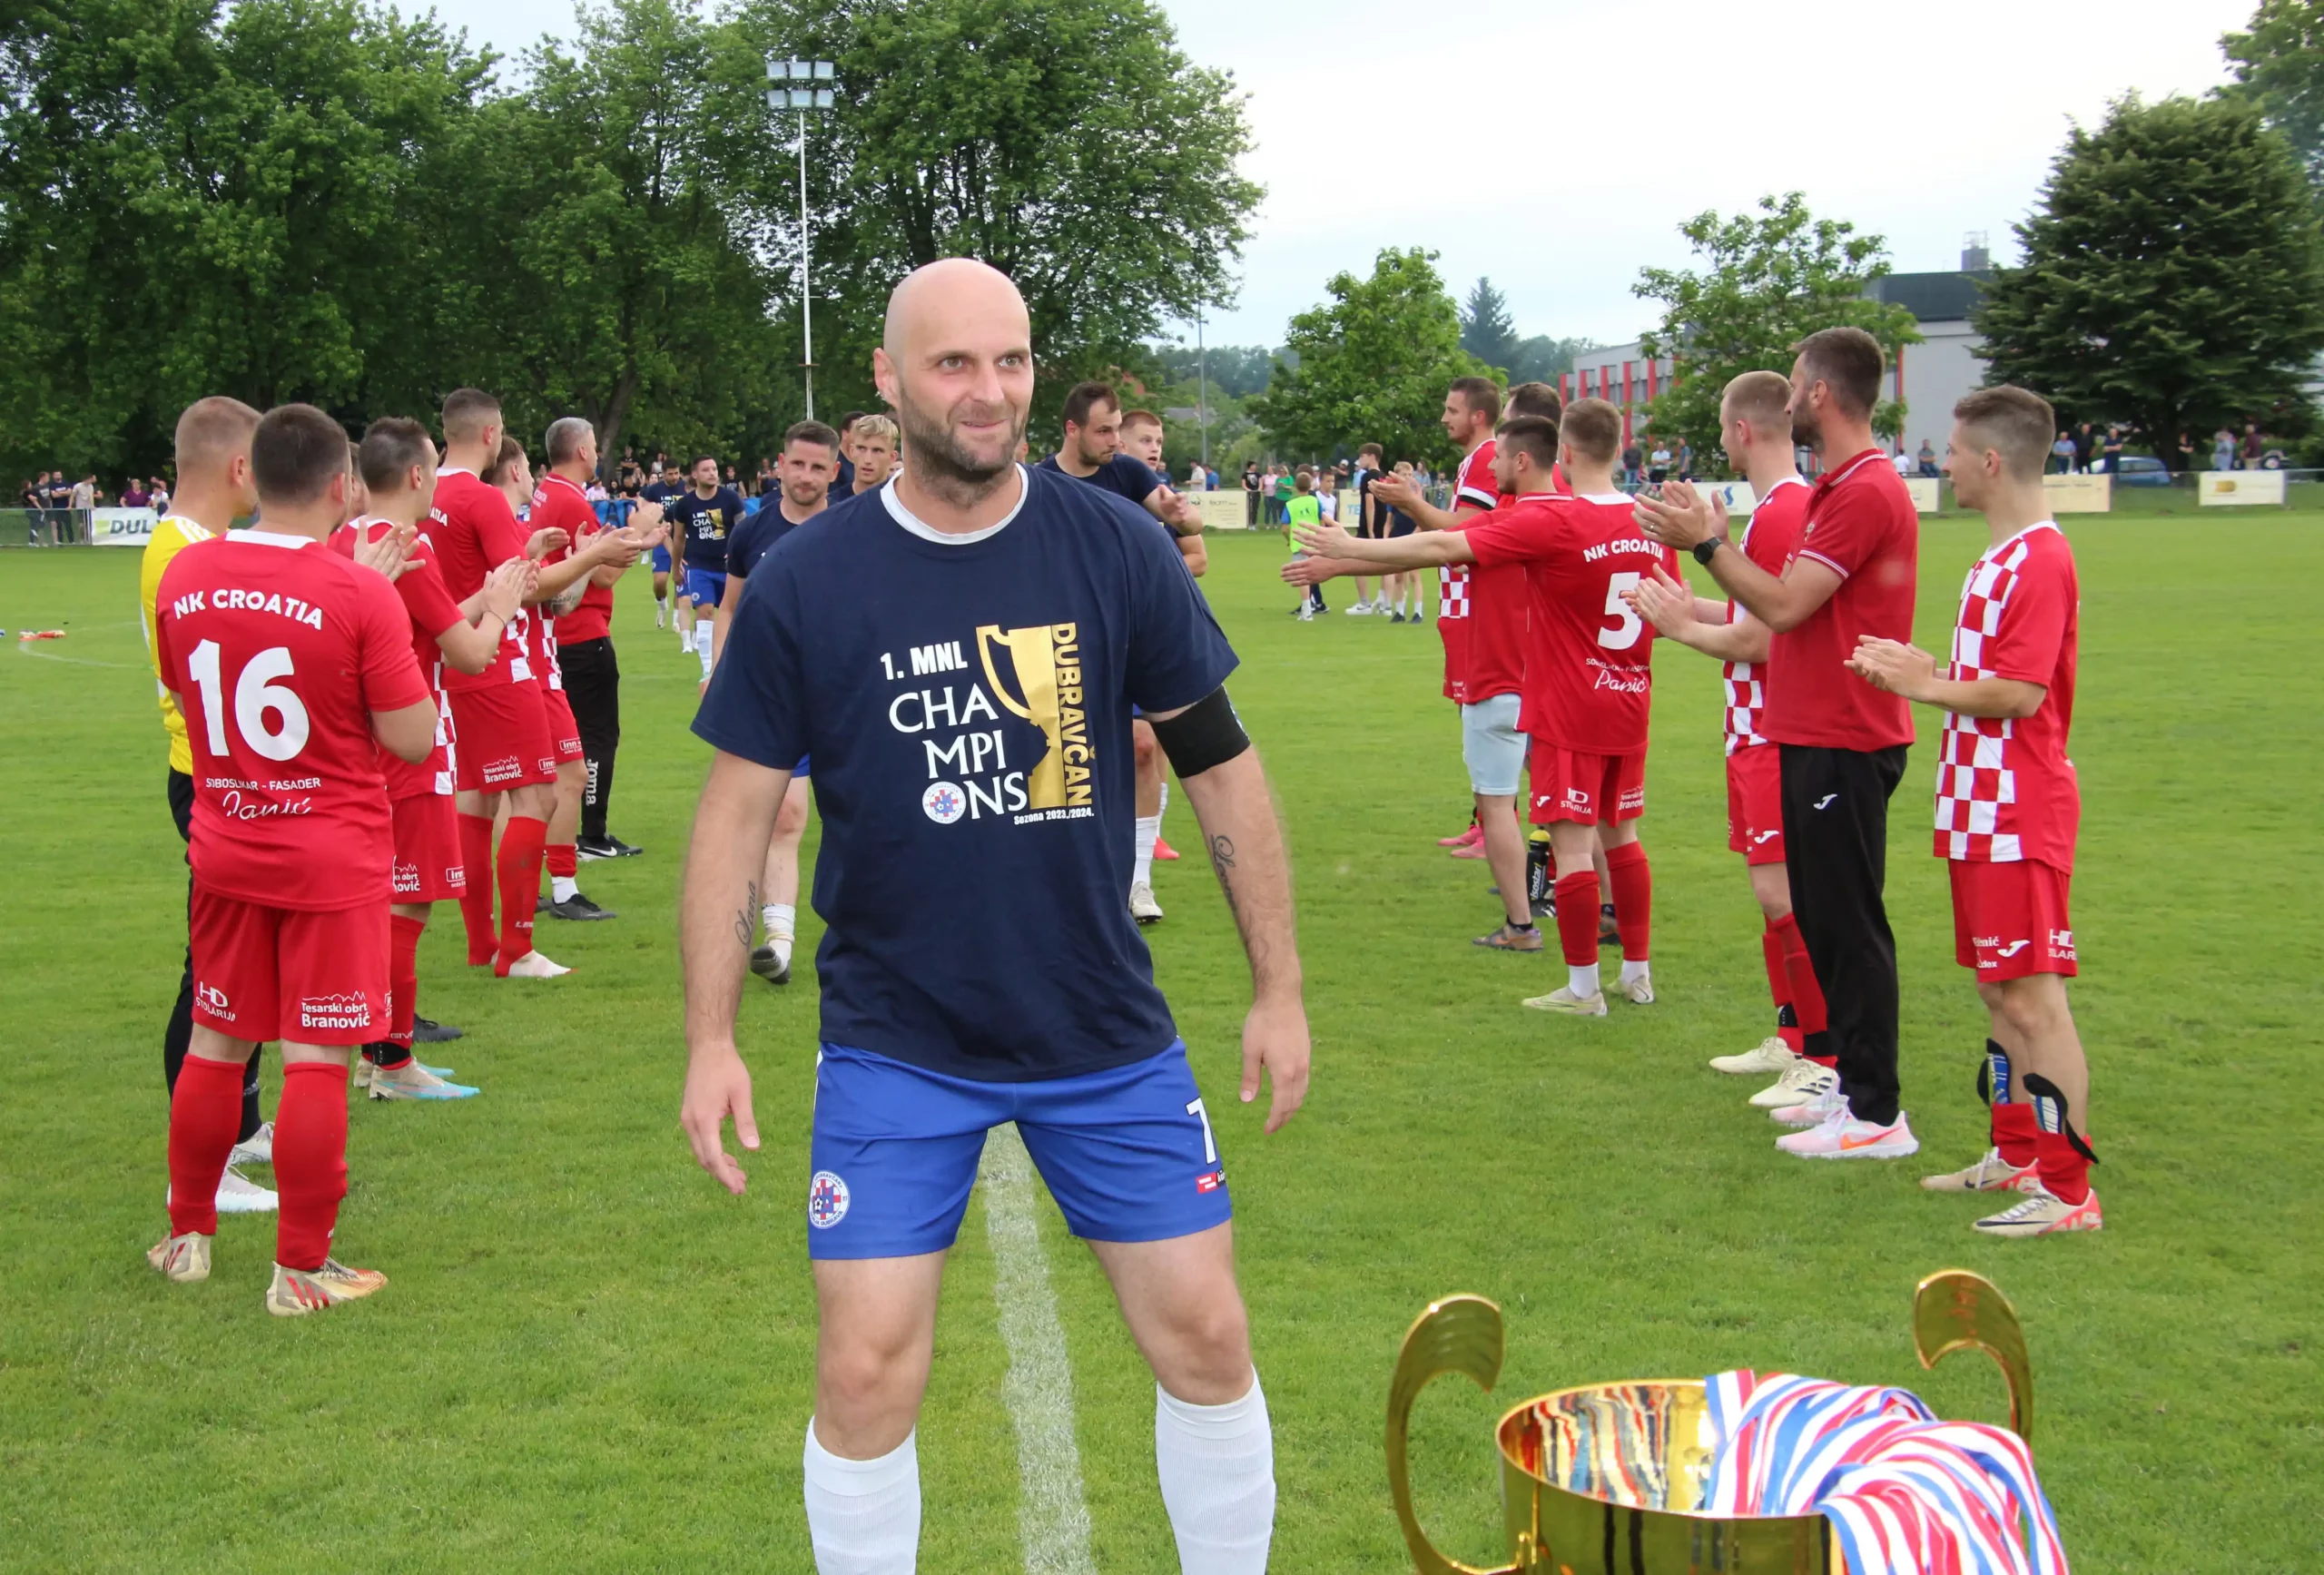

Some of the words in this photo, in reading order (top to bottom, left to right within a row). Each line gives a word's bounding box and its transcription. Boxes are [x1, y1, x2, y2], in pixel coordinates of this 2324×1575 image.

[110, 519, 160, 535] DUL
[429, 506, 448, 527] ATIA
[693, 518, 711, 527] CHA
[1583, 544, 1609, 563] NK
[1610, 538, 1663, 562] CROATIA
[173, 591, 206, 620] NK
[212, 589, 322, 631] CROATIA
[1597, 571, 1642, 650] 5
[880, 652, 905, 680] 1.
[910, 640, 969, 676] MNL
[188, 638, 310, 762] 16
[889, 683, 1000, 733] CHA
[1050, 622, 1096, 807] DUBRAVČAN
[922, 729, 1007, 779] MPI
[270, 777, 321, 791] FASADER
[484, 767, 523, 783] Branović
[1013, 812, 1044, 825] Sezona
[1530, 865, 1541, 900] isostar
[200, 980, 229, 1008] HD
[195, 996, 236, 1022] STOLARIJA
[301, 1001, 342, 1014] Tesarski
[345, 1001, 368, 1012] obrt
[301, 1012, 370, 1029] Branović
